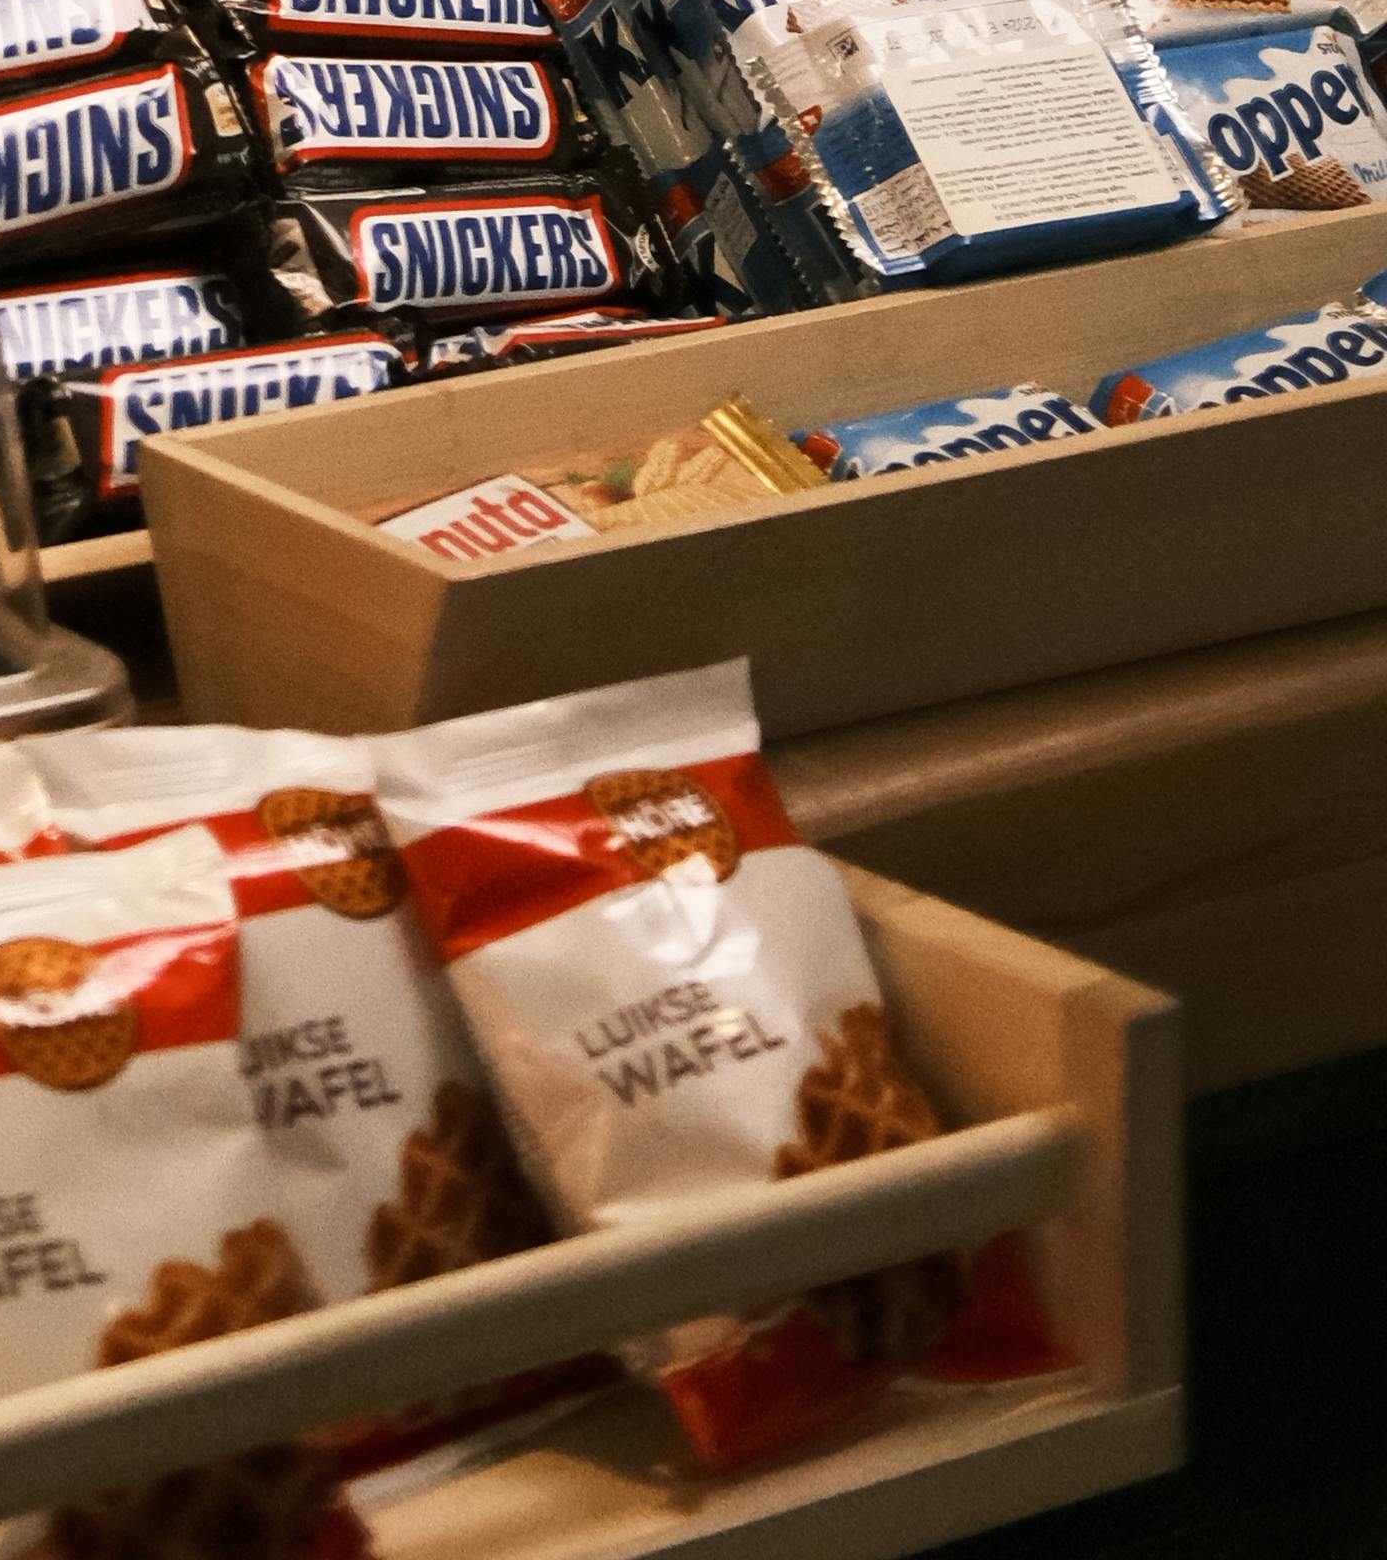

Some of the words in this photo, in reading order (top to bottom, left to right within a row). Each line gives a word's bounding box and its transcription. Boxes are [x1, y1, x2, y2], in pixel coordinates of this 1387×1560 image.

[275, 61, 542, 146] SNICKERS
[1208, 63, 1373, 177] opper
[372, 213, 610, 303] SNICKERS
[575, 981, 721, 1059] LUIKSE
[596, 1010, 789, 1109] WAFEL
[257, 1058, 403, 1133] AFEL
